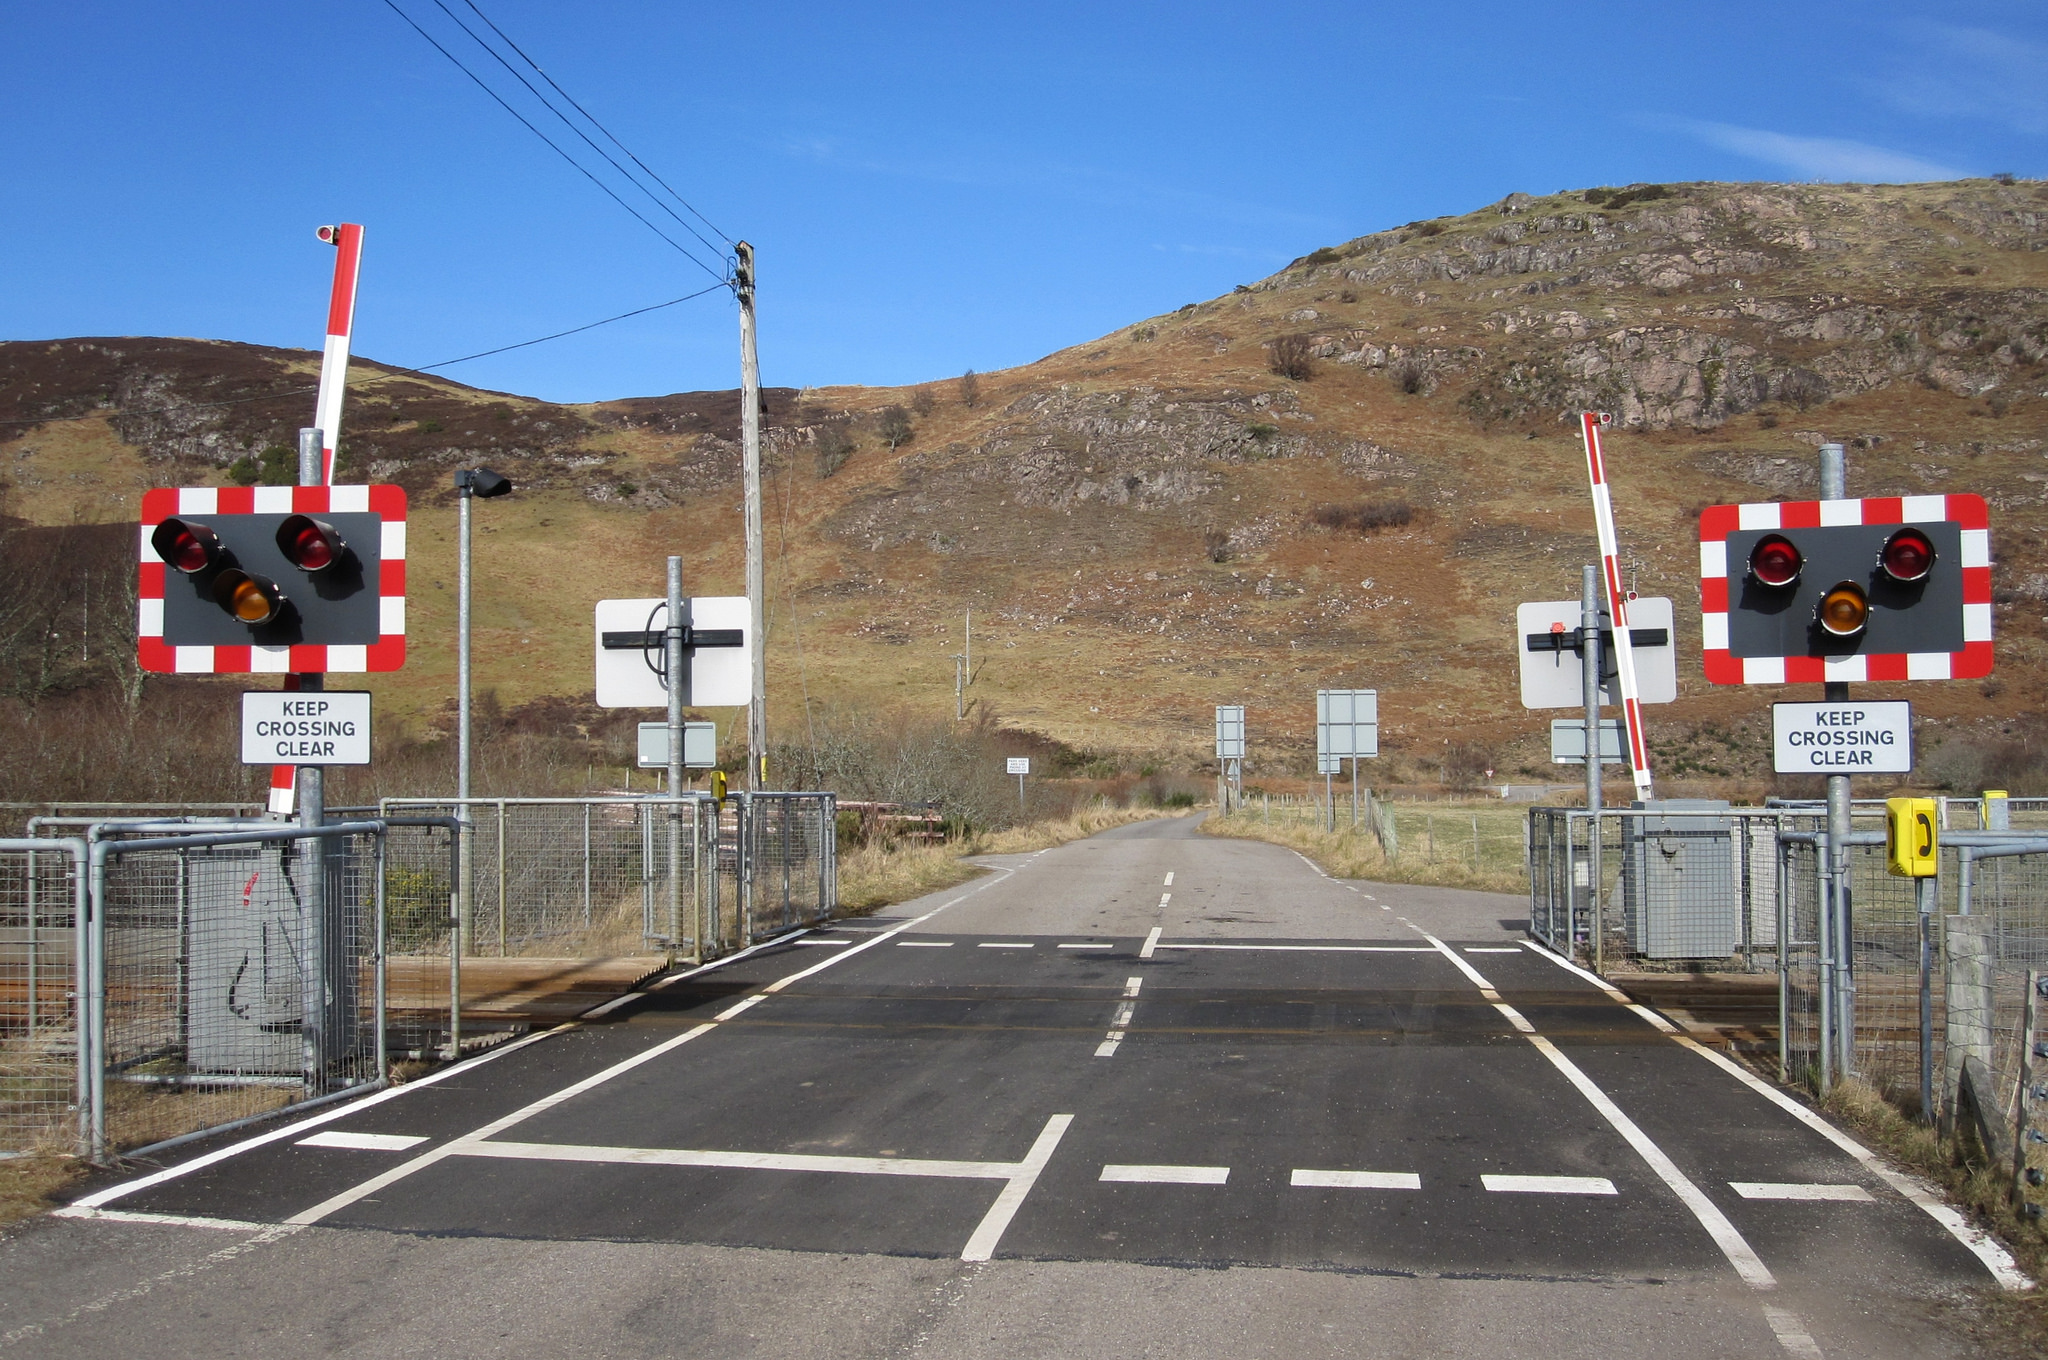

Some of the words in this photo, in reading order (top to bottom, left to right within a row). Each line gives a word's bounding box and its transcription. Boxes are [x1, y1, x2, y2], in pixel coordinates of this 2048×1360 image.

[283, 701, 329, 716] KEEP
[1816, 710, 1865, 726] KEEP
[256, 721, 355, 737] CROSSING
[1788, 730, 1894, 746] CROSSING
[276, 741, 335, 757] CLEAR
[1810, 750, 1873, 766] CLEAR
